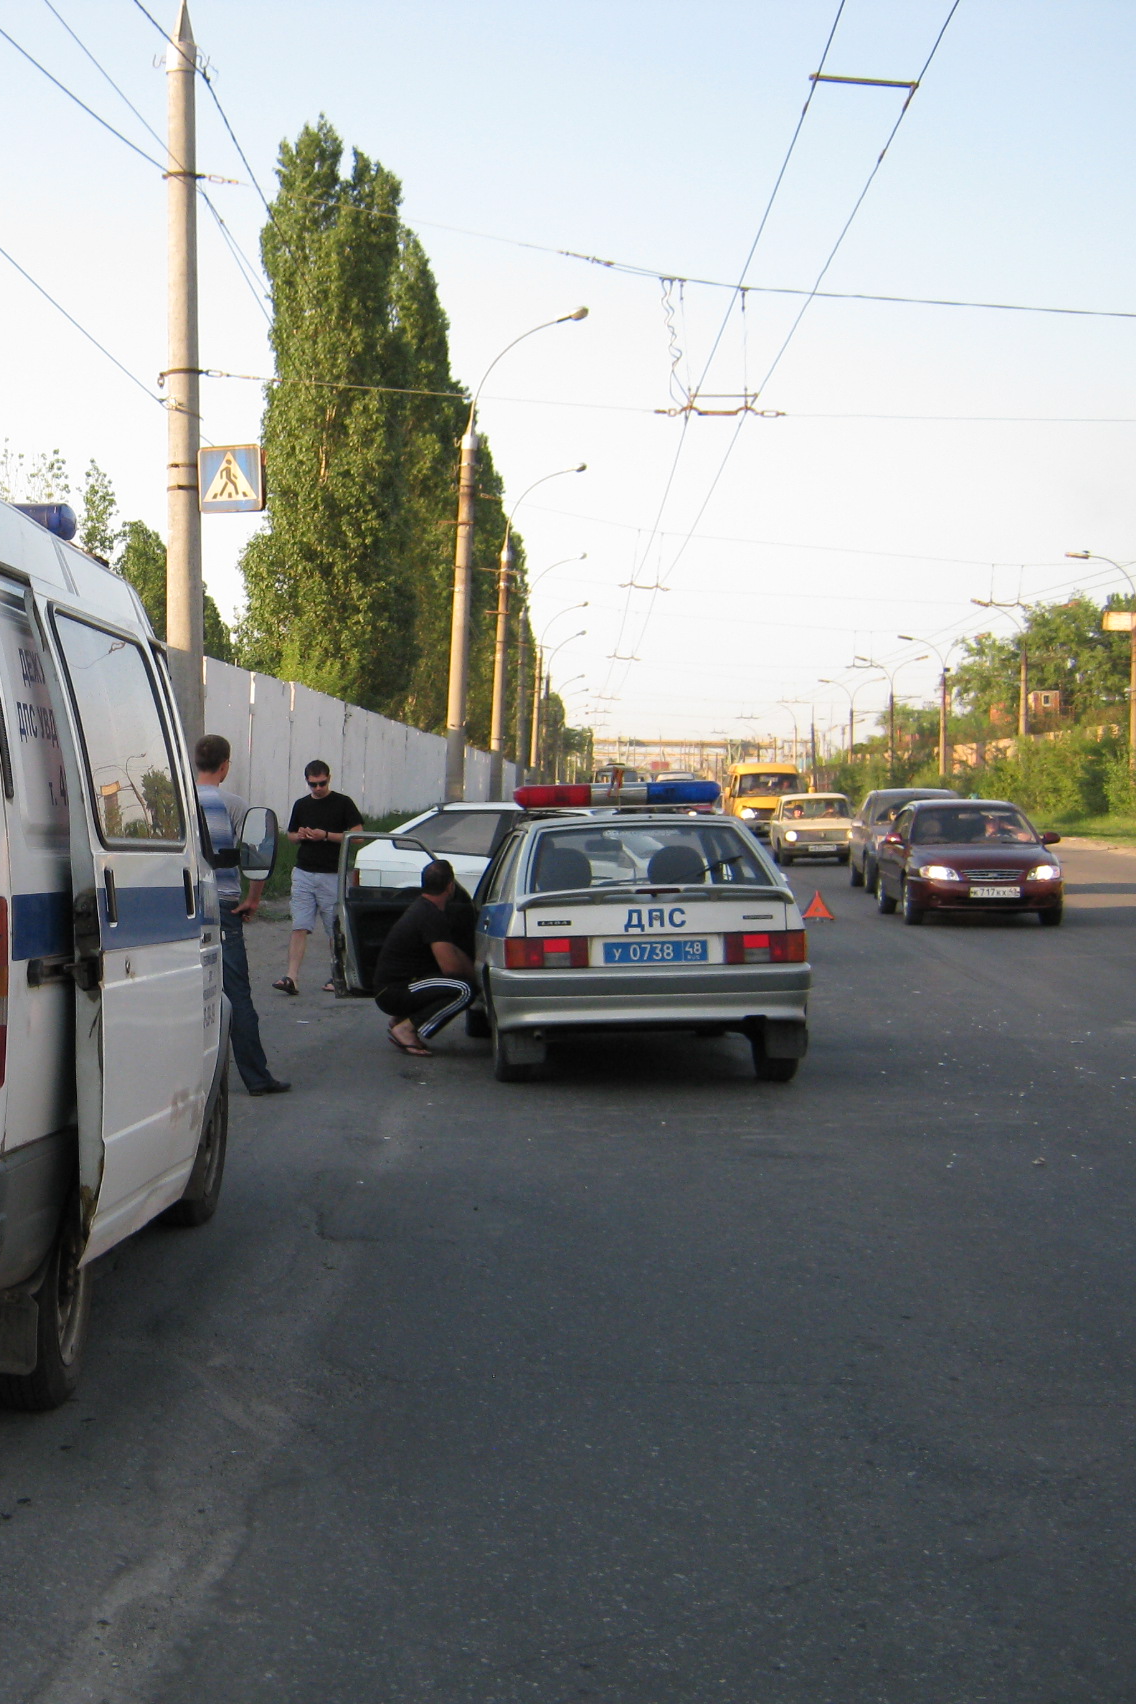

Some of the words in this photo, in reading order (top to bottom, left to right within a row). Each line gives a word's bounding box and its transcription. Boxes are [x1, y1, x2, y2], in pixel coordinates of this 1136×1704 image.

[16, 701, 38, 743] ДПС
[624, 907, 687, 932] ДПС
[629, 943, 674, 960] 0738
[685, 942, 702, 955] 48
